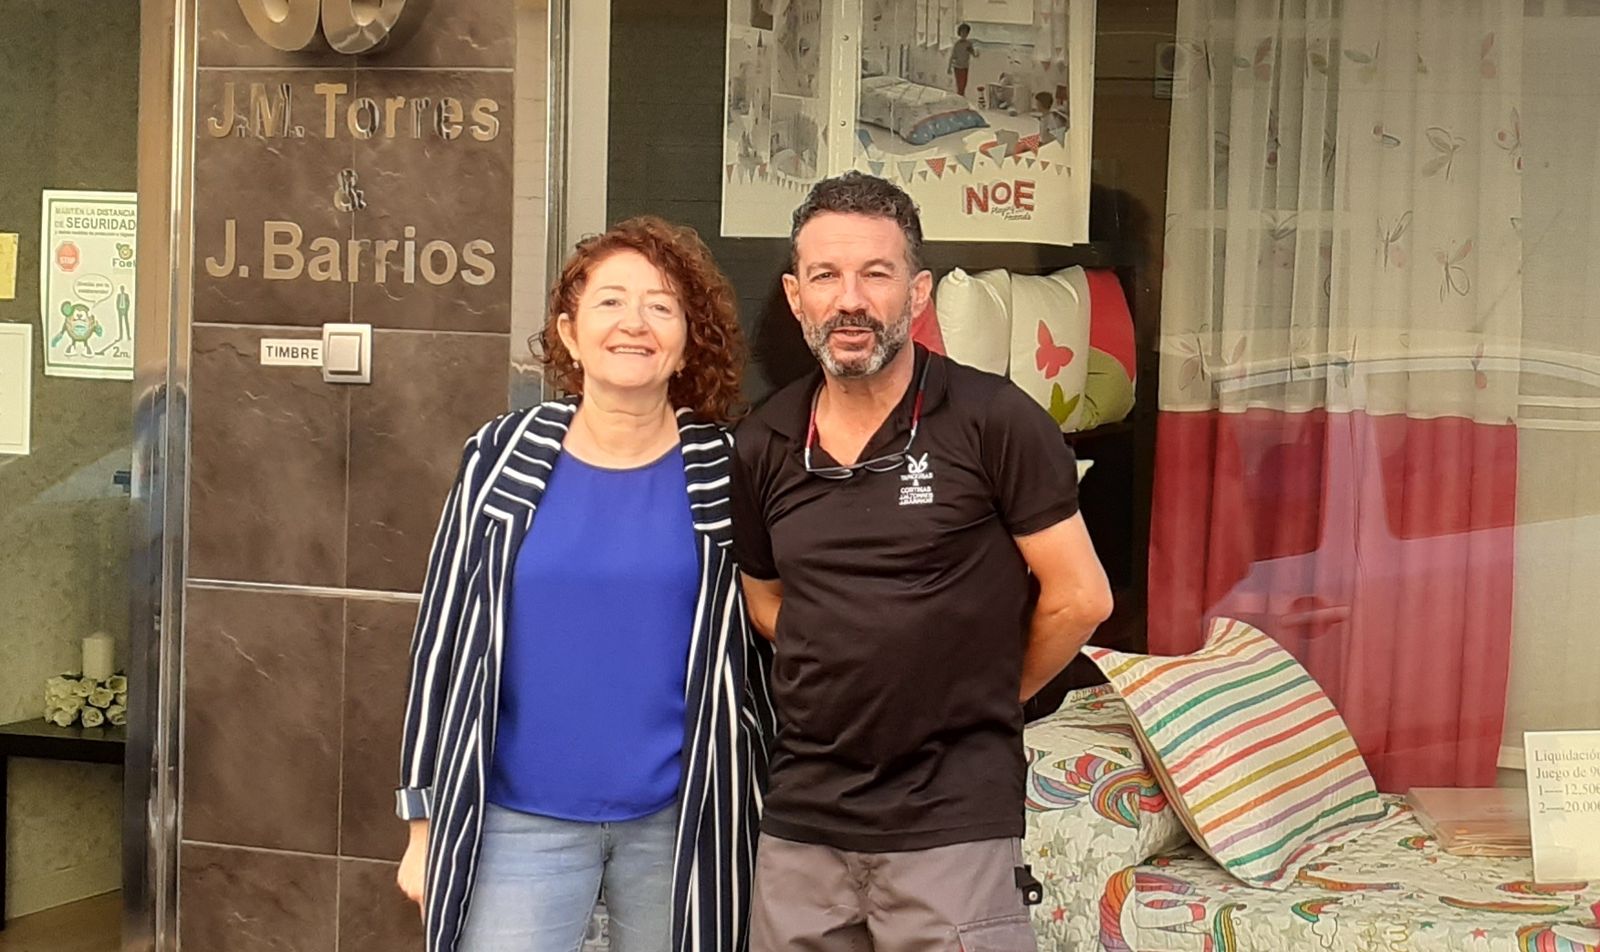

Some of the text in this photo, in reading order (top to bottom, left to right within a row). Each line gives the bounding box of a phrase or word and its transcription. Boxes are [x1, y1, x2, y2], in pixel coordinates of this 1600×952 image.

[207, 83, 500, 141] J.M. Torres
[333, 168, 368, 212] &
[963, 180, 1035, 215] NOE
[66, 217, 136, 230] SEGURIDAD
[96, 208, 135, 217] DISTANCIA
[205, 219, 496, 285] J. Barrios
[265, 345, 319, 360] TIMBRE
[1536, 767, 1570, 781] Juego
[1573, 766, 1586, 778] de
